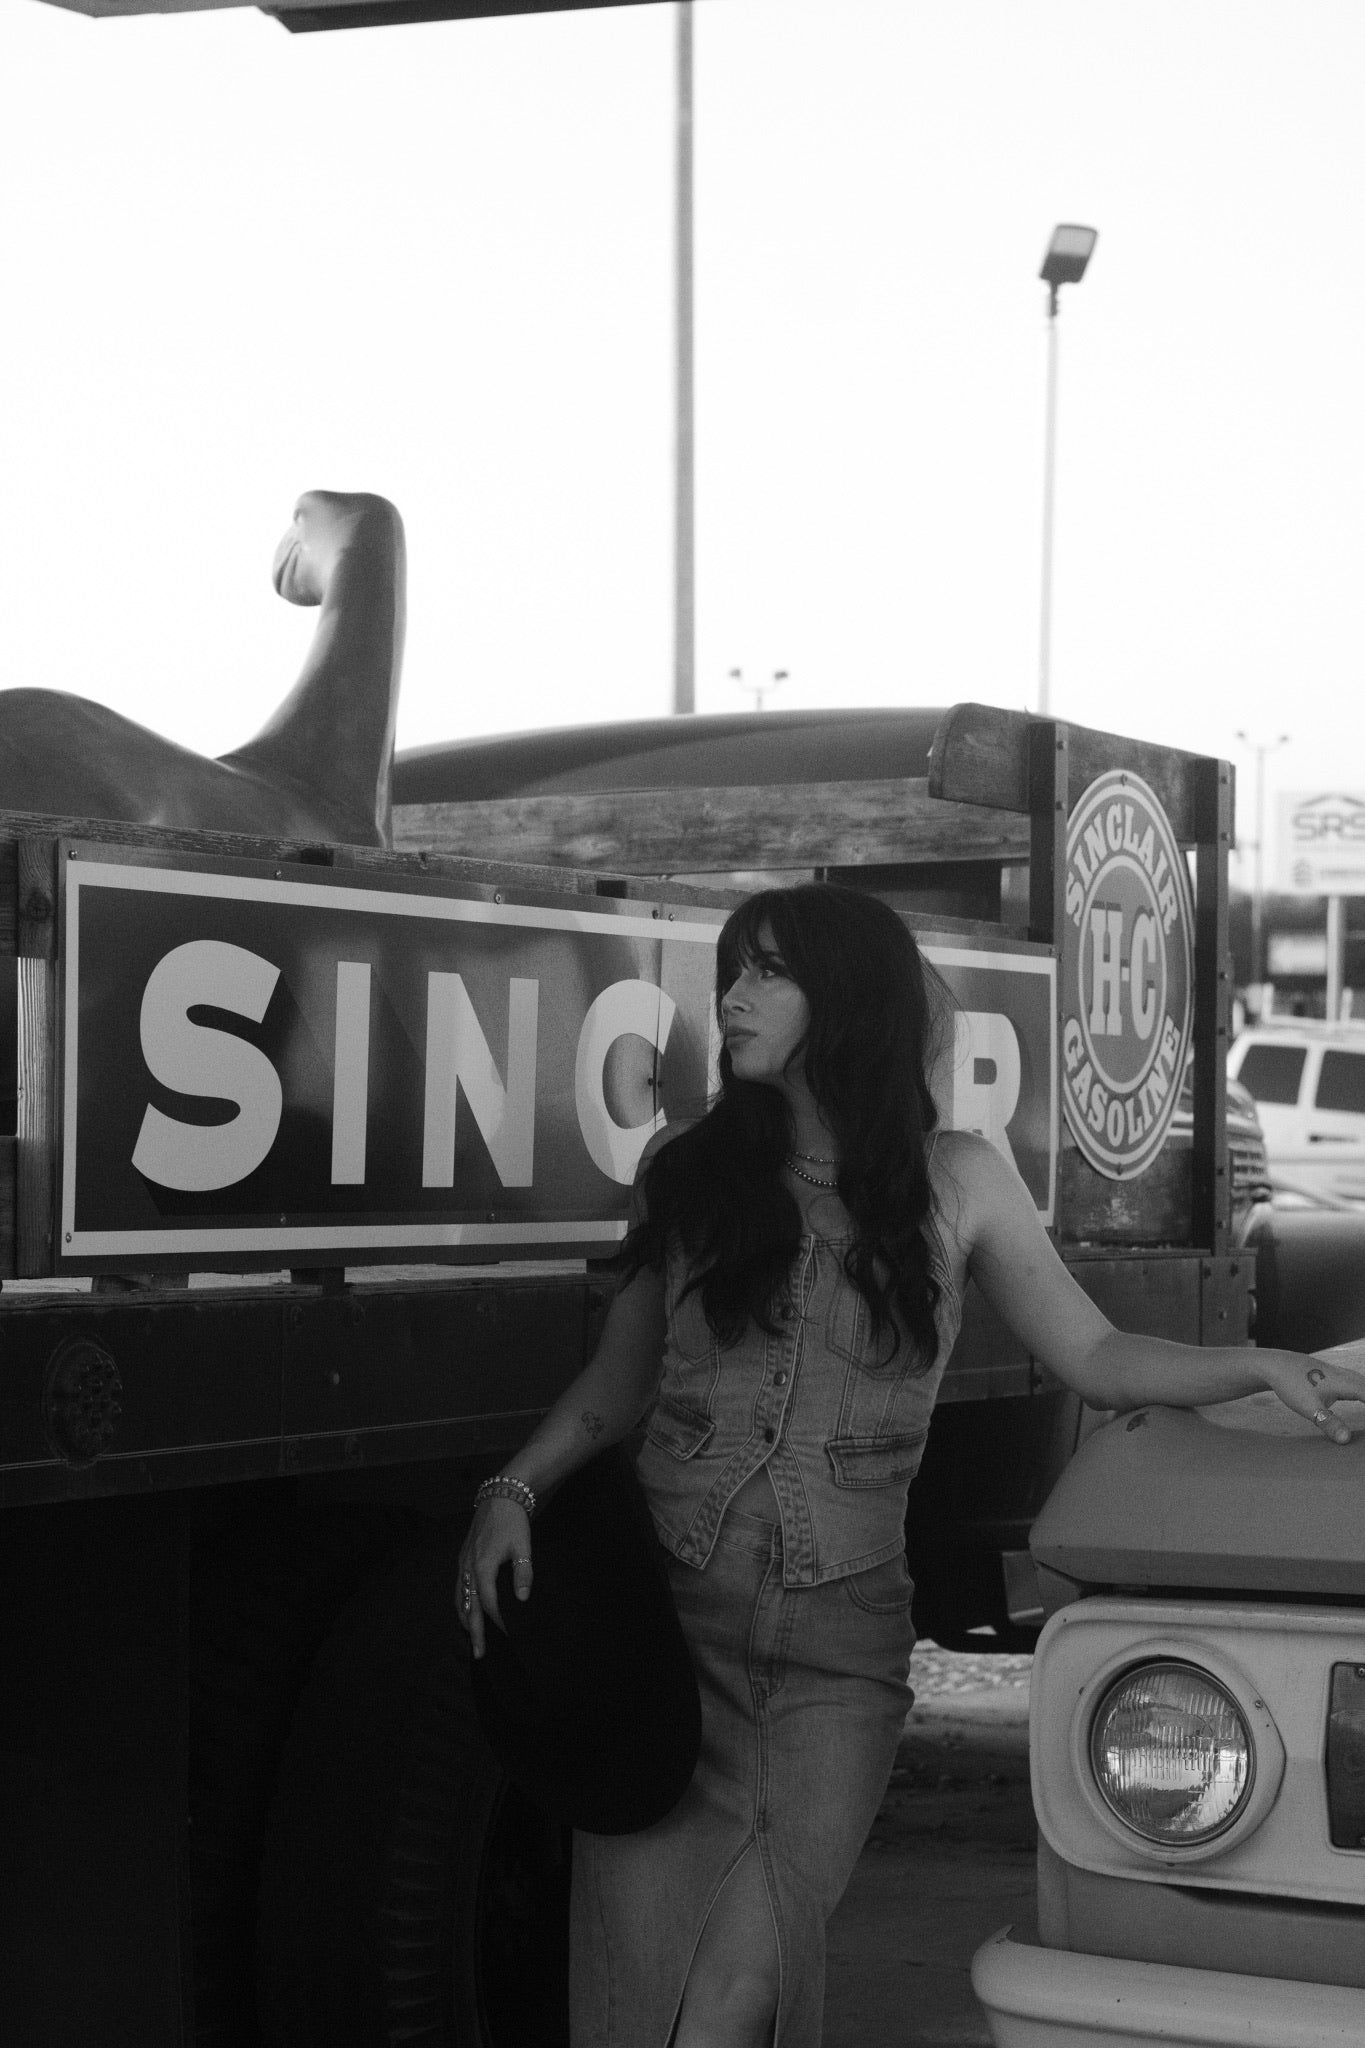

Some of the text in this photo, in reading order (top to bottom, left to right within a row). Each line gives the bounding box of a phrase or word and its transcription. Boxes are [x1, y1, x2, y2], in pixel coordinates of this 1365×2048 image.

[1066, 803, 1178, 935] SINCLAIR
[1089, 906, 1157, 1041] H-C
[131, 939, 1021, 1192] SINCR
[1063, 1016, 1181, 1147] GASOLINE
